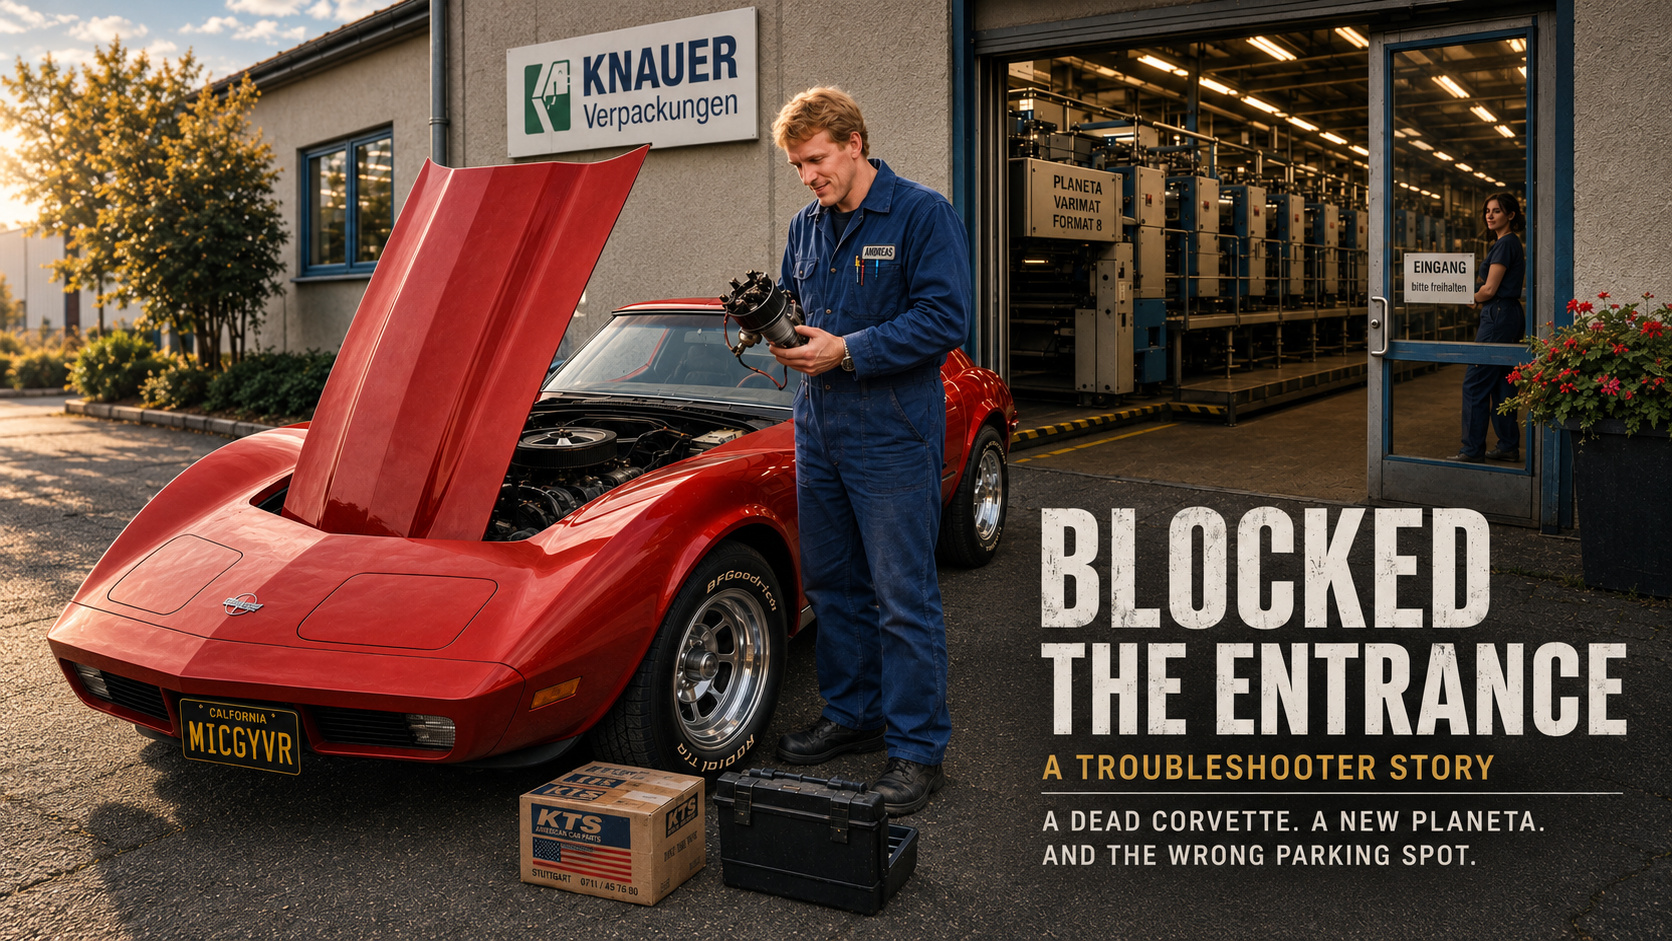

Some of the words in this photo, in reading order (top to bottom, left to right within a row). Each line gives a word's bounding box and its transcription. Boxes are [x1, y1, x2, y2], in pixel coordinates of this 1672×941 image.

[583, 35, 738, 97] KNAUER
[583, 93, 738, 132] Verpackungen
[1053, 174, 1103, 196] PLANETA
[1053, 194, 1101, 214] VARIMAT
[1053, 213, 1094, 231] FORMAT
[1096, 218, 1103, 232] 8
[1414, 260, 1467, 274] EINGANG
[1411, 281, 1429, 292] bitte
[1430, 281, 1467, 293] freihalten
[188, 720, 293, 766] MICGYVR
[537, 808, 603, 834] KTS
[668, 797, 697, 830] KTS
